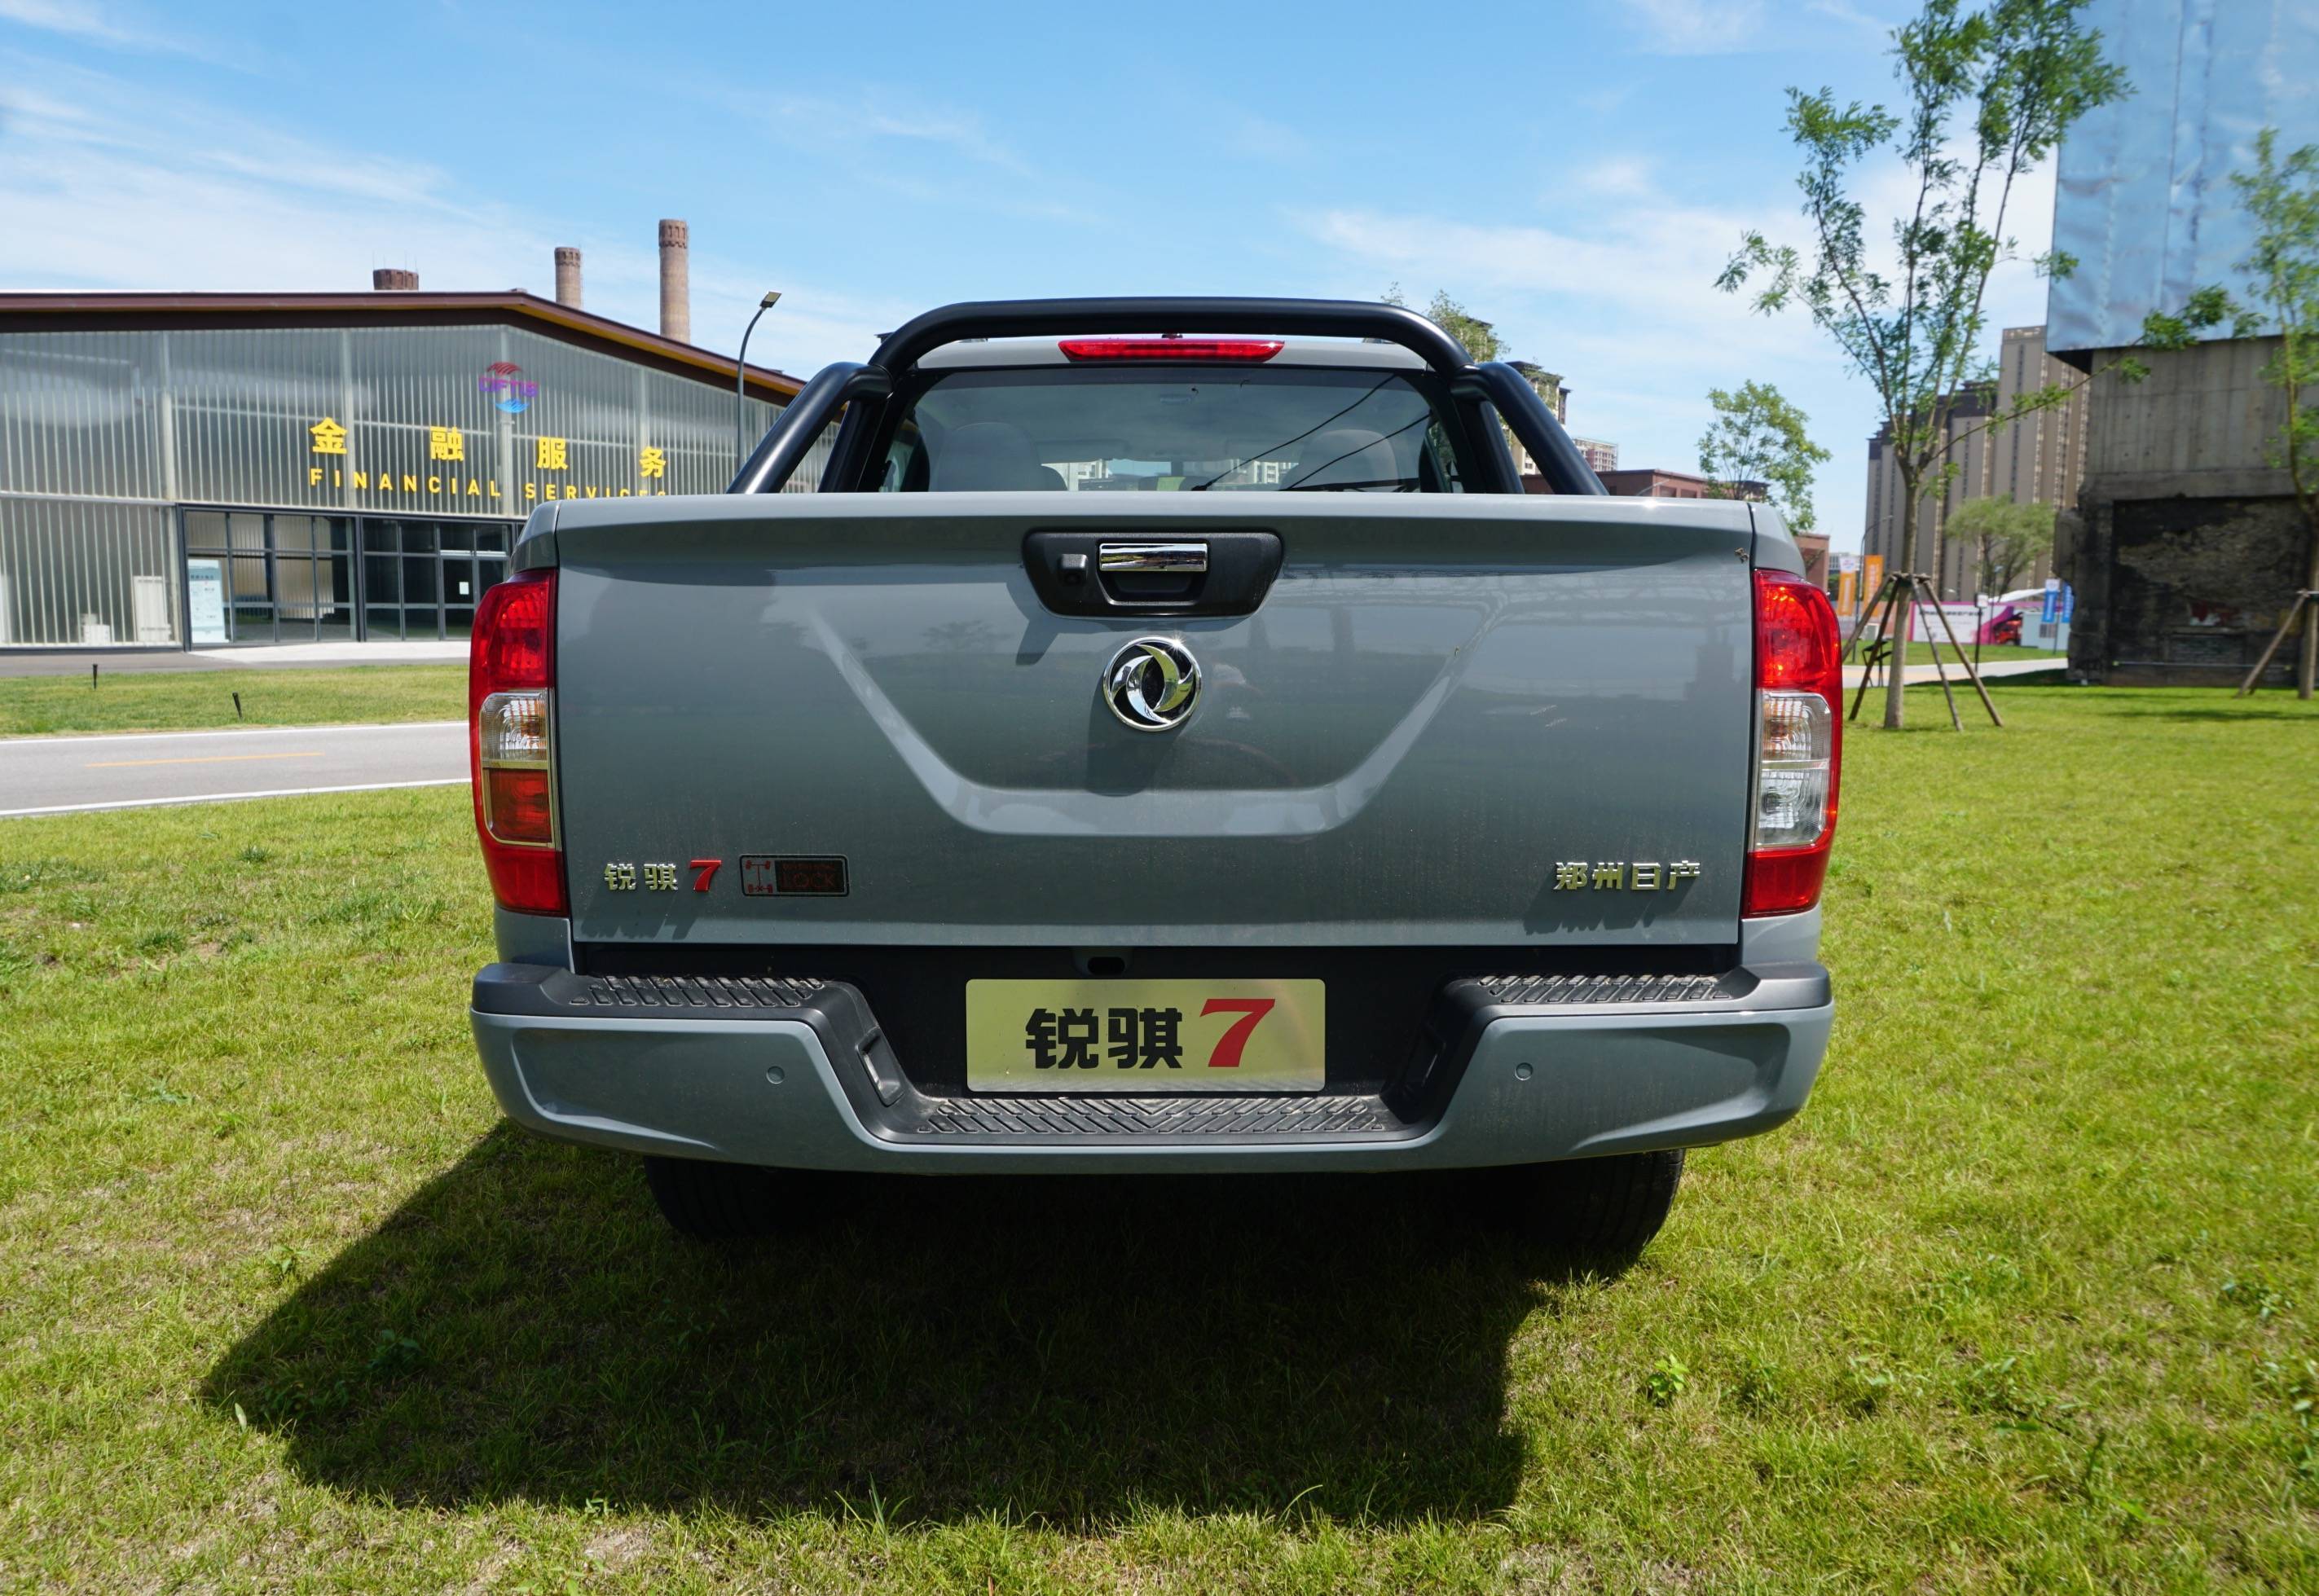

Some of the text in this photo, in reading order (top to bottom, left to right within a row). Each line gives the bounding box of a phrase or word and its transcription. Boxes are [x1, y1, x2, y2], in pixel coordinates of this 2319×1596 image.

[310, 416, 667, 477] 金融服务
[310, 468, 666, 499] FINANCIAL SERVIC
[781, 873, 835, 888] LOCK
[1553, 860, 1701, 890] 郑州日产
